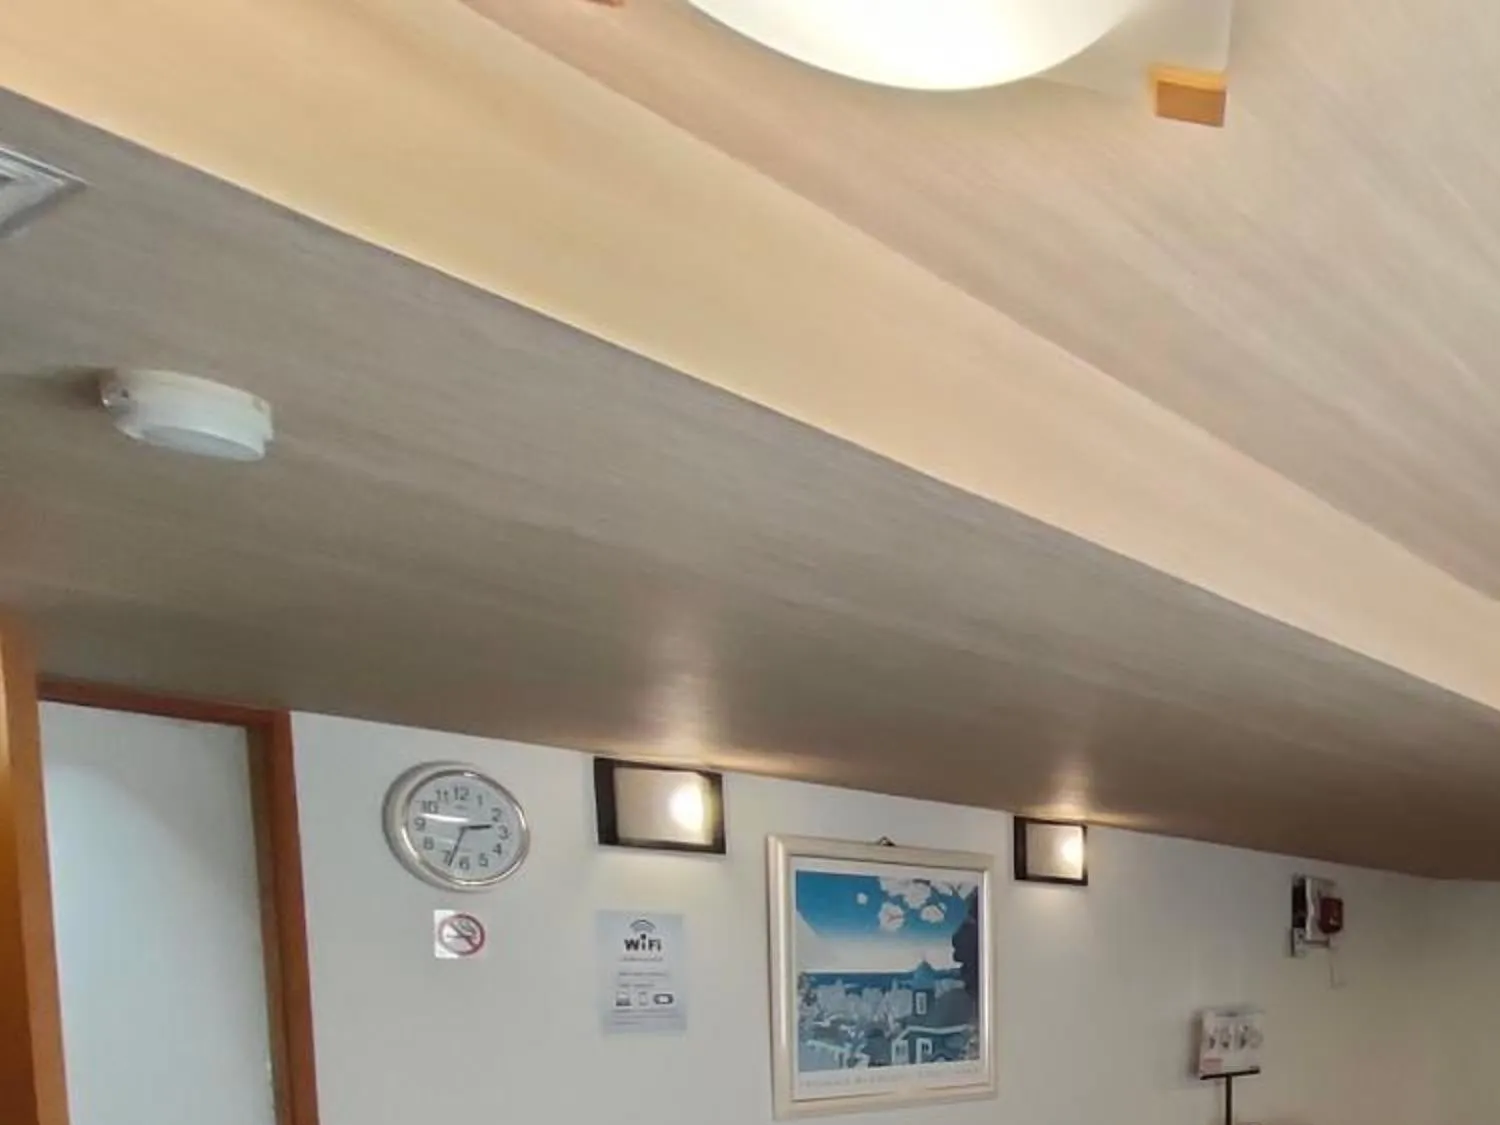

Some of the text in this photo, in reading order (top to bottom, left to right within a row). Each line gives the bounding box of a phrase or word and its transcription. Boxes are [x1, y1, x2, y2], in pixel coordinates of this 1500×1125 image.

[454, 786, 470, 801] 12
[422, 801, 439, 814] 10
[491, 807, 502, 822] 2
[414, 817, 426, 831] 9
[499, 824, 509, 840] 3
[424, 836, 435, 850] 8
[492, 842, 502, 856] 4
[460, 856, 470, 870] 6
[479, 853, 489, 867] 5
